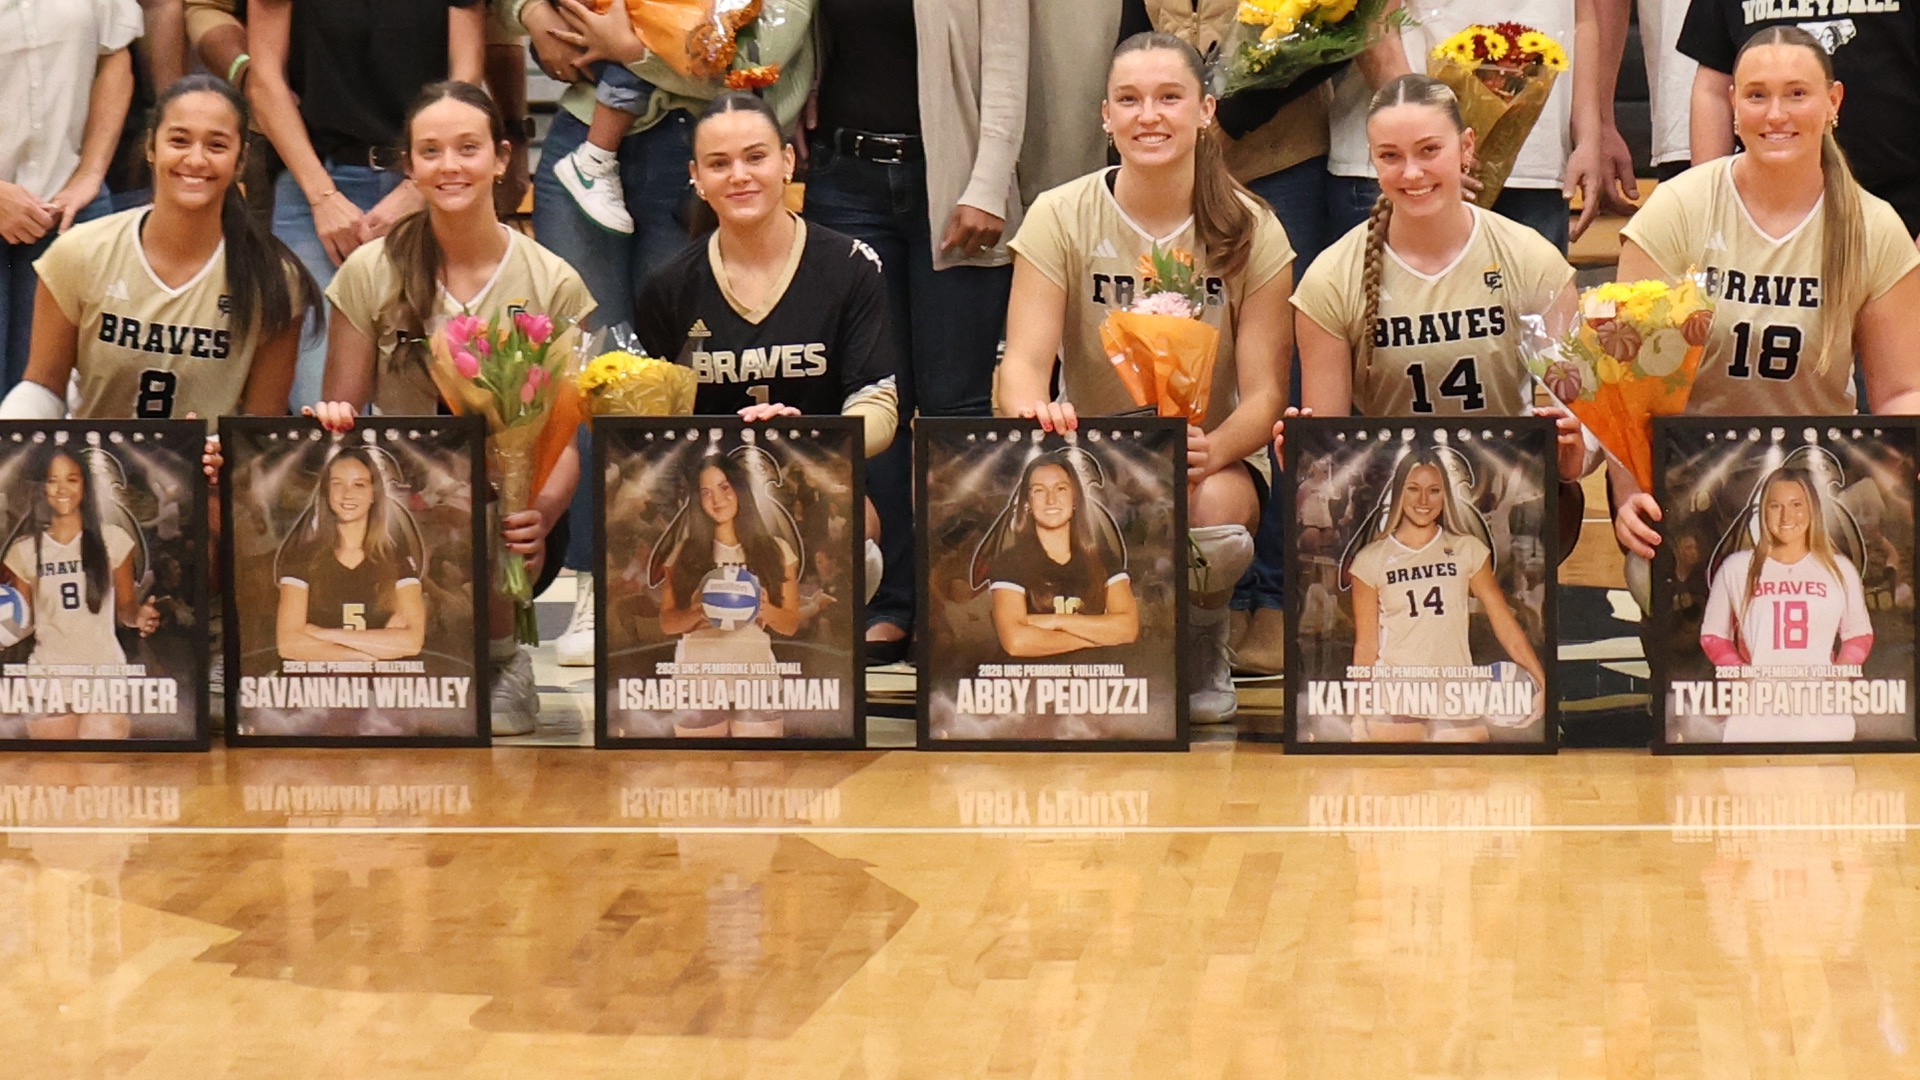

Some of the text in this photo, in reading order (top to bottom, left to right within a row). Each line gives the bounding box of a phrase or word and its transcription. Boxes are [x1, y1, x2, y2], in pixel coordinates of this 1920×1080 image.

[1706, 266, 1824, 308] BRAVE
[98, 312, 231, 360] BRAVES
[1375, 305, 1506, 348] BRAVES
[692, 343, 827, 384] BRAVES
[1727, 321, 1803, 380] 18
[136, 369, 177, 418] 8
[1406, 357, 1485, 413] 14
[1386, 562, 1457, 585] BRAVES
[1754, 580, 1827, 598] BRAVES
[61, 582, 80, 610] 8
[1405, 586, 1445, 618] 14
[342, 603, 367, 631] 5
[1772, 601, 1809, 650] 18
[1073, 664, 1125, 677] VOLLEYBALL
[1441, 665, 1493, 678] VOLLEYBALL
[71, 677, 179, 714] CARTER
[239, 676, 471, 709] SAVANNAH WHALEY
[618, 678, 840, 711] ISABELLA DILLMAN
[956, 678, 1148, 715] ABBY PEDUZZI
[1308, 680, 1533, 716] KATELYNN SWAIN
[1671, 679, 1907, 716] TYLER PATTERSON
